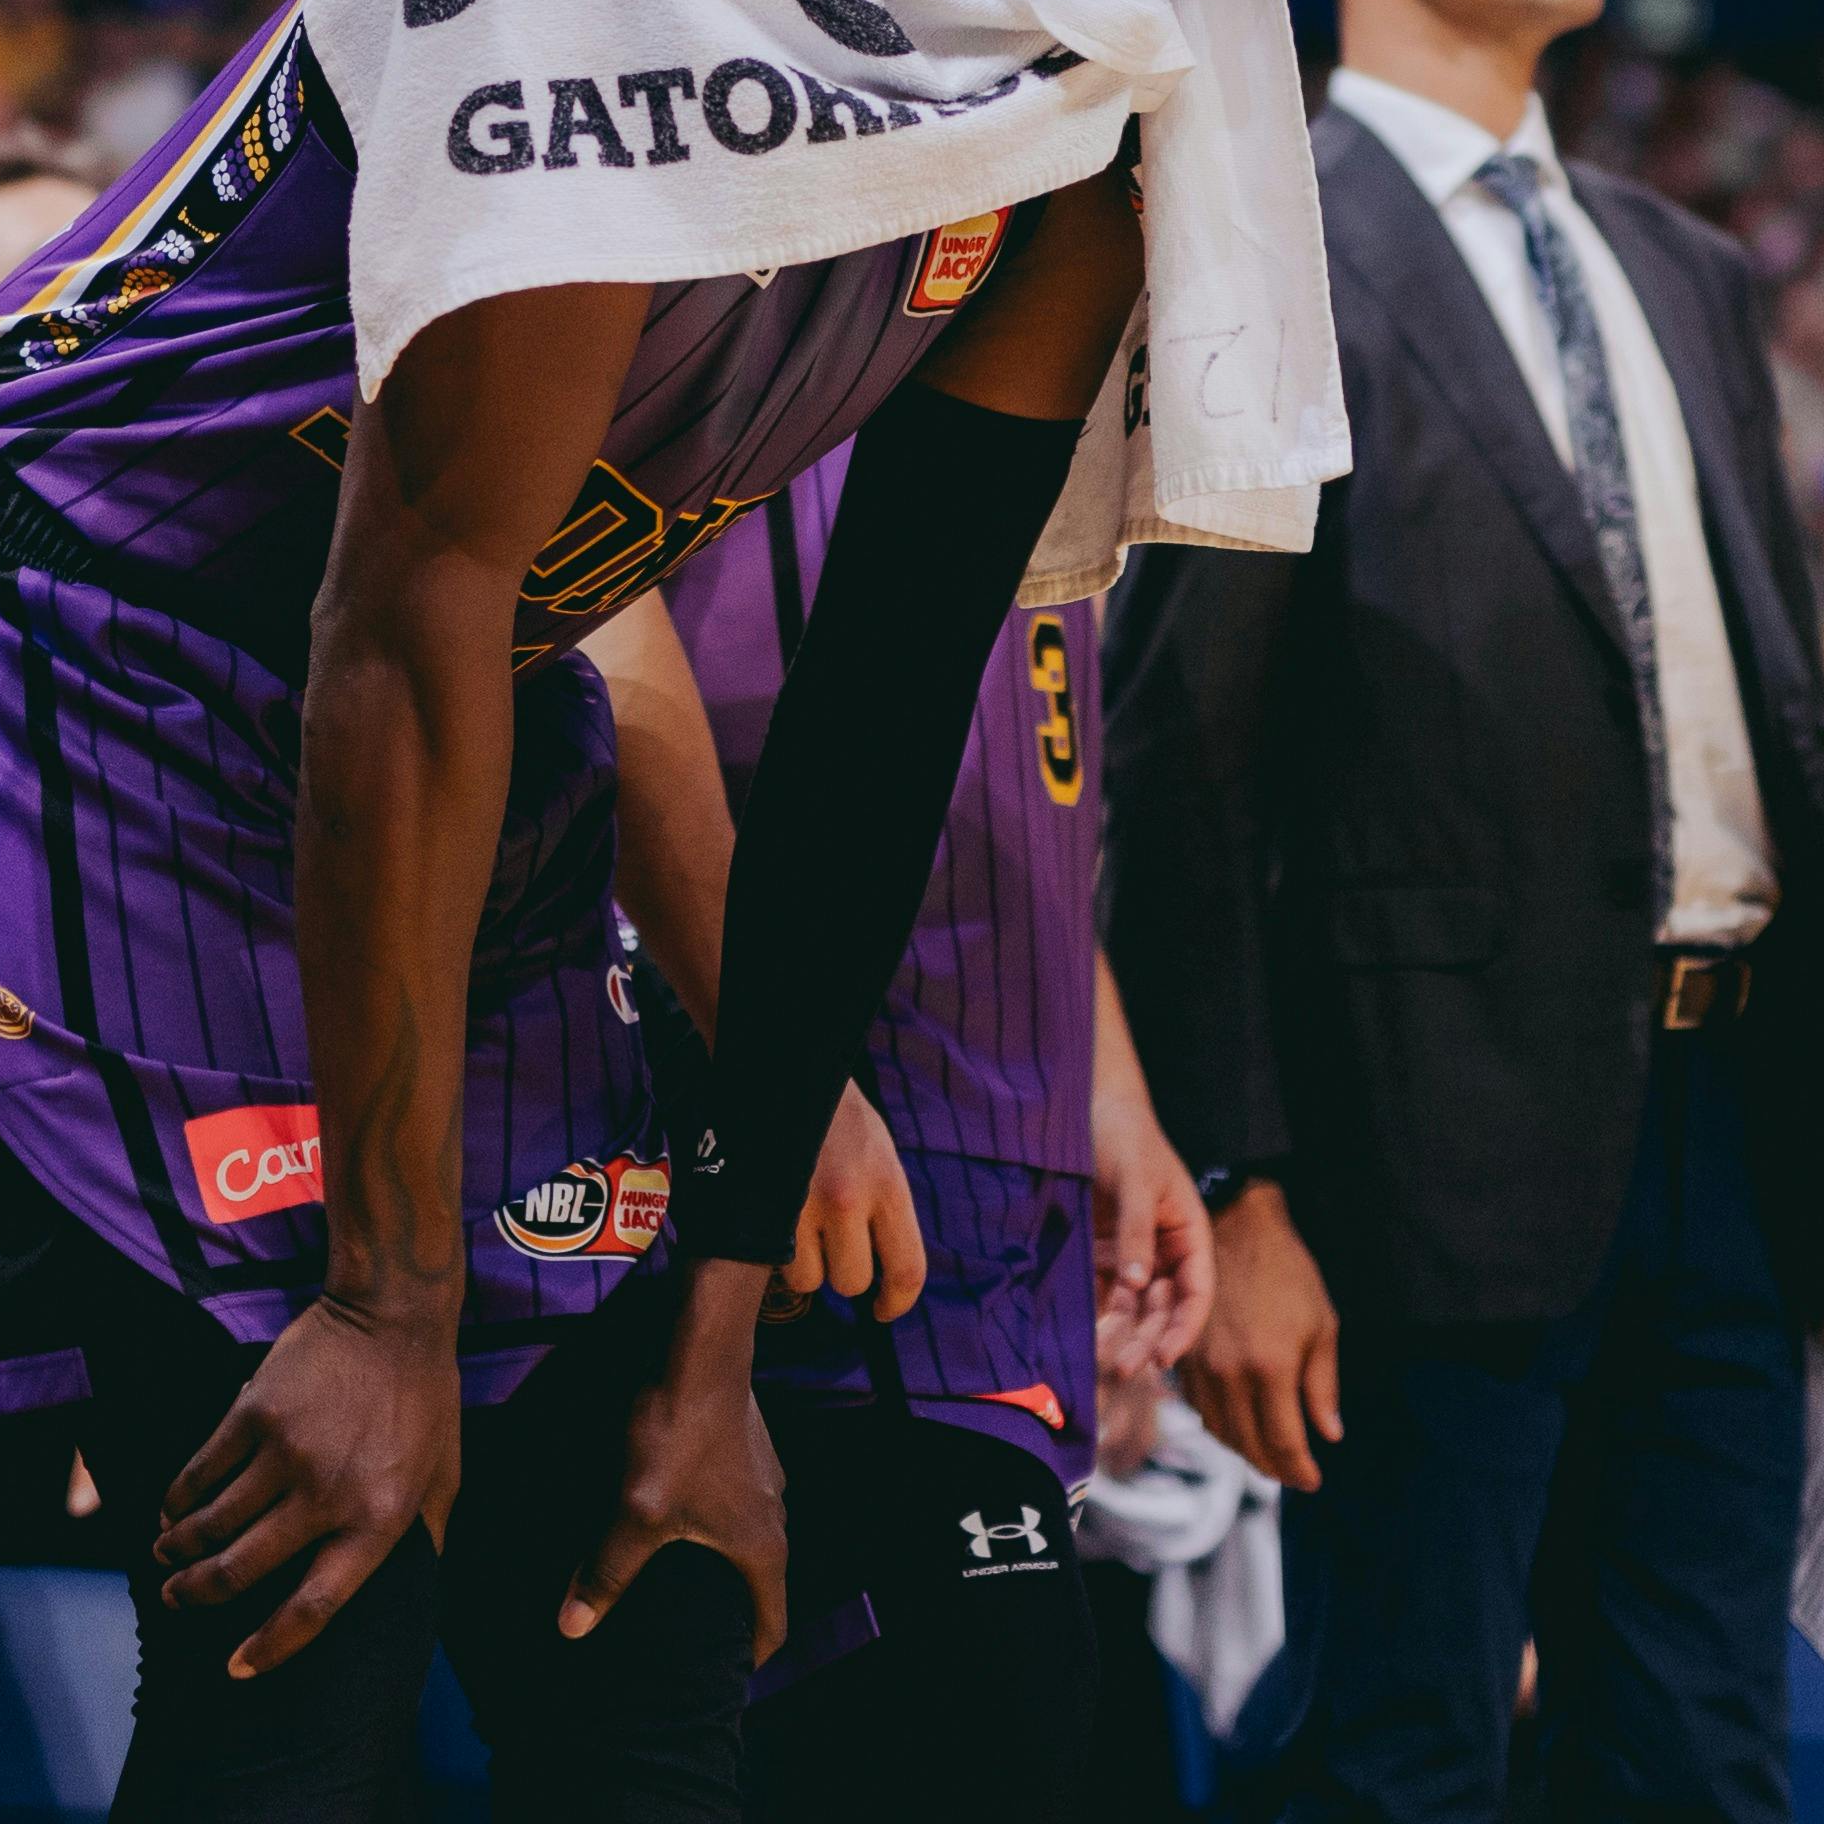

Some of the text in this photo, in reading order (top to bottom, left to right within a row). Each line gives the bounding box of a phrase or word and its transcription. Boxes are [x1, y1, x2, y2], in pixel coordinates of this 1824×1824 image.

[526, 1183, 587, 1224] NBL
[620, 1190, 668, 1209] HUNGR
[962, 1561, 1058, 1578] UNDER ARMOUR
